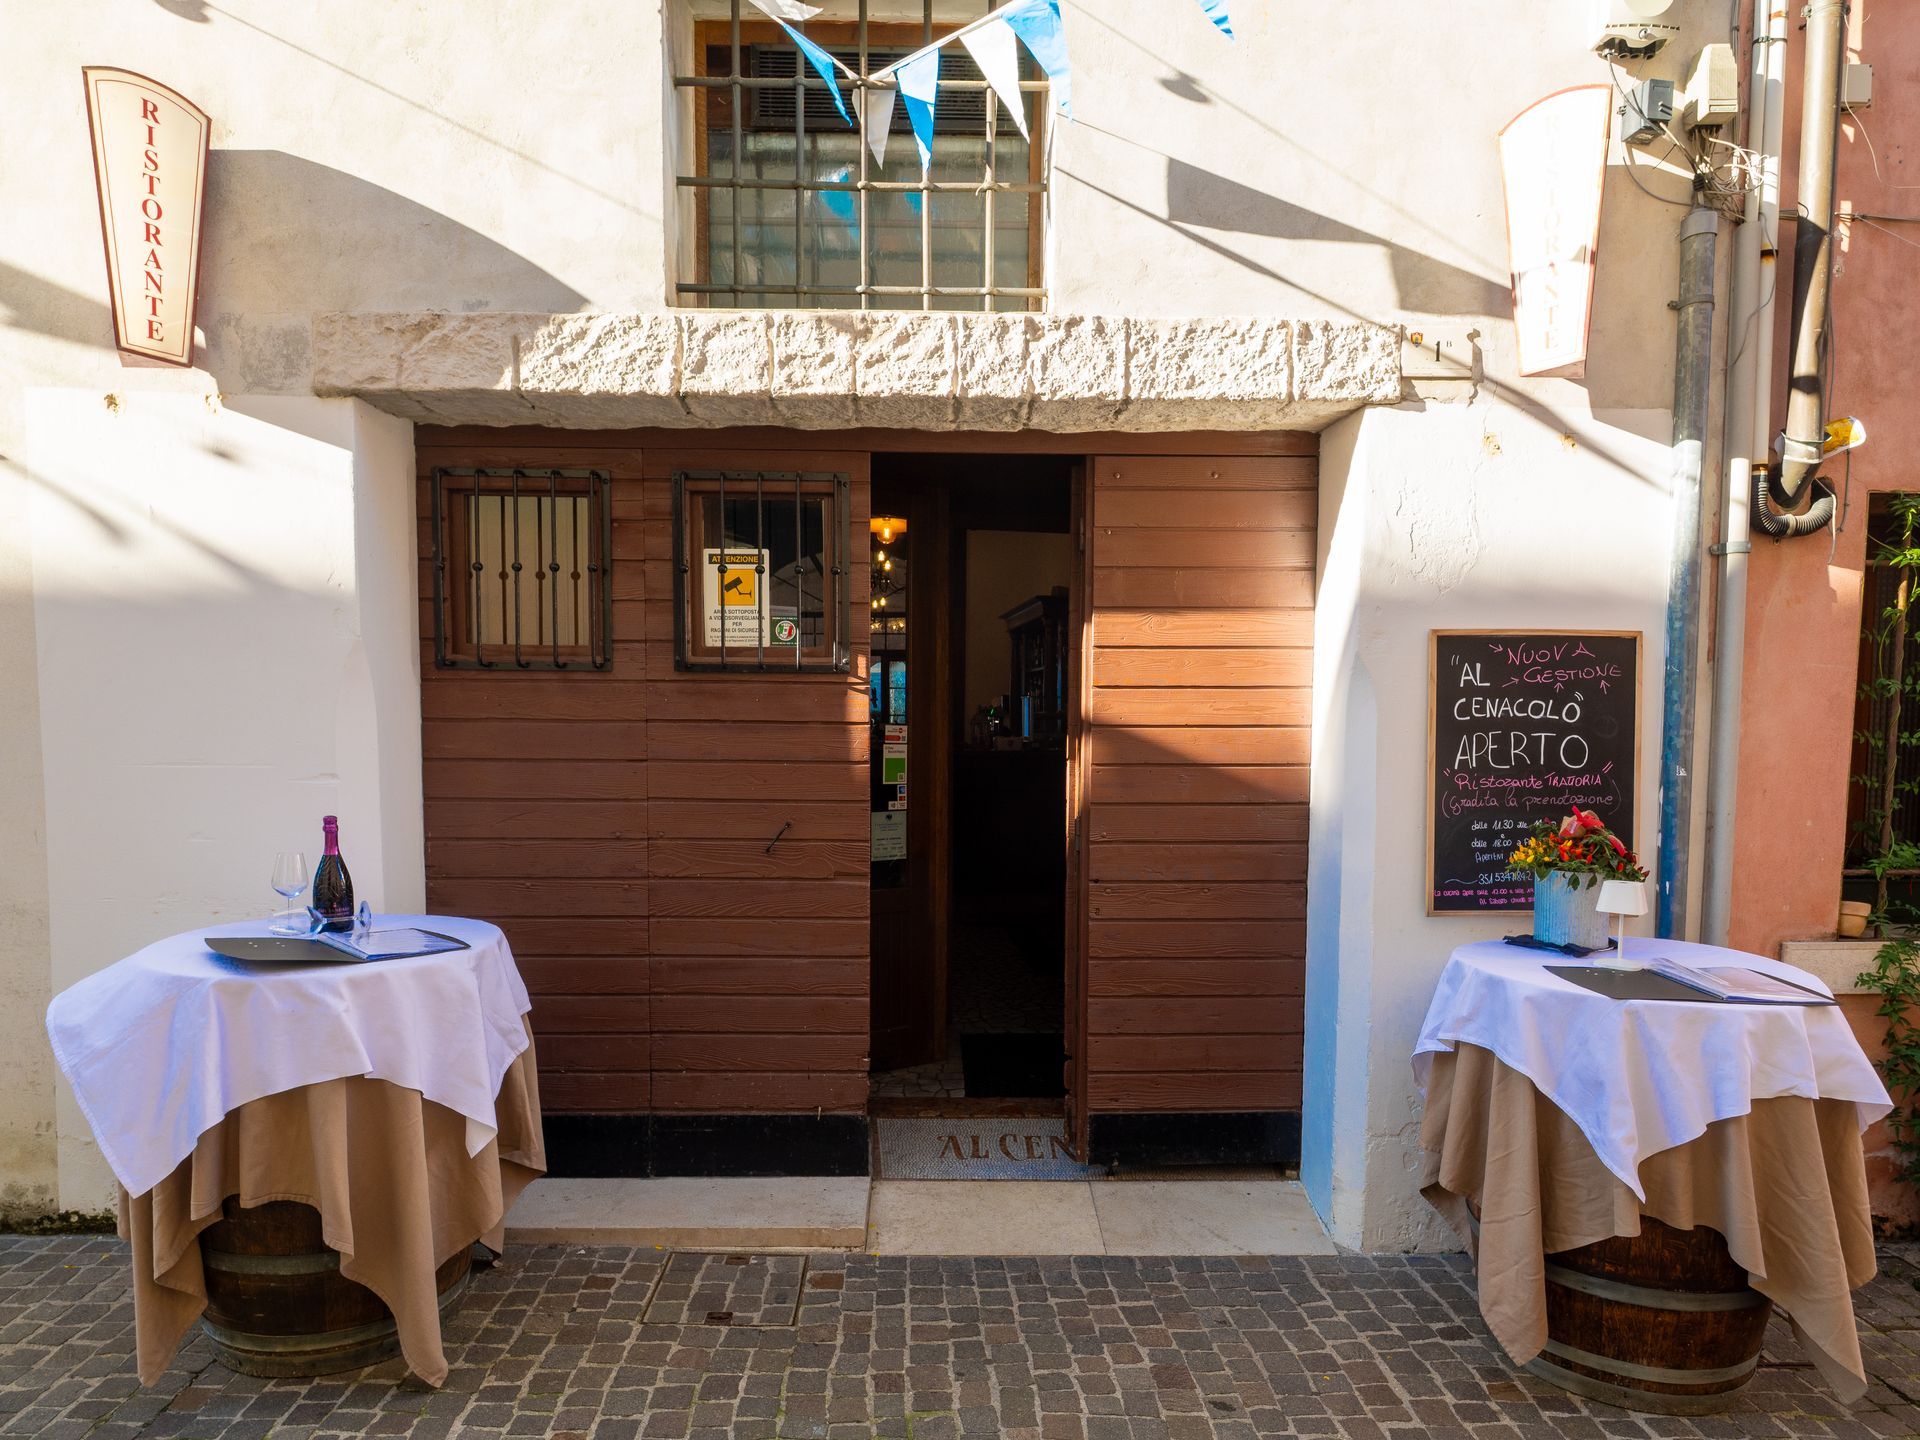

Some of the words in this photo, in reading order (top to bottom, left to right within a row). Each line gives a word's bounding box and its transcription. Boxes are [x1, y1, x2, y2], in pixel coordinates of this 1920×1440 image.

[140, 97, 164, 342] RISTORANTE
[1507, 642, 1596, 665] NUOVA
[1523, 665, 1622, 683] GESTIONE
[1454, 731, 1589, 769] APERTO
[936, 1135, 989, 1160] AL
